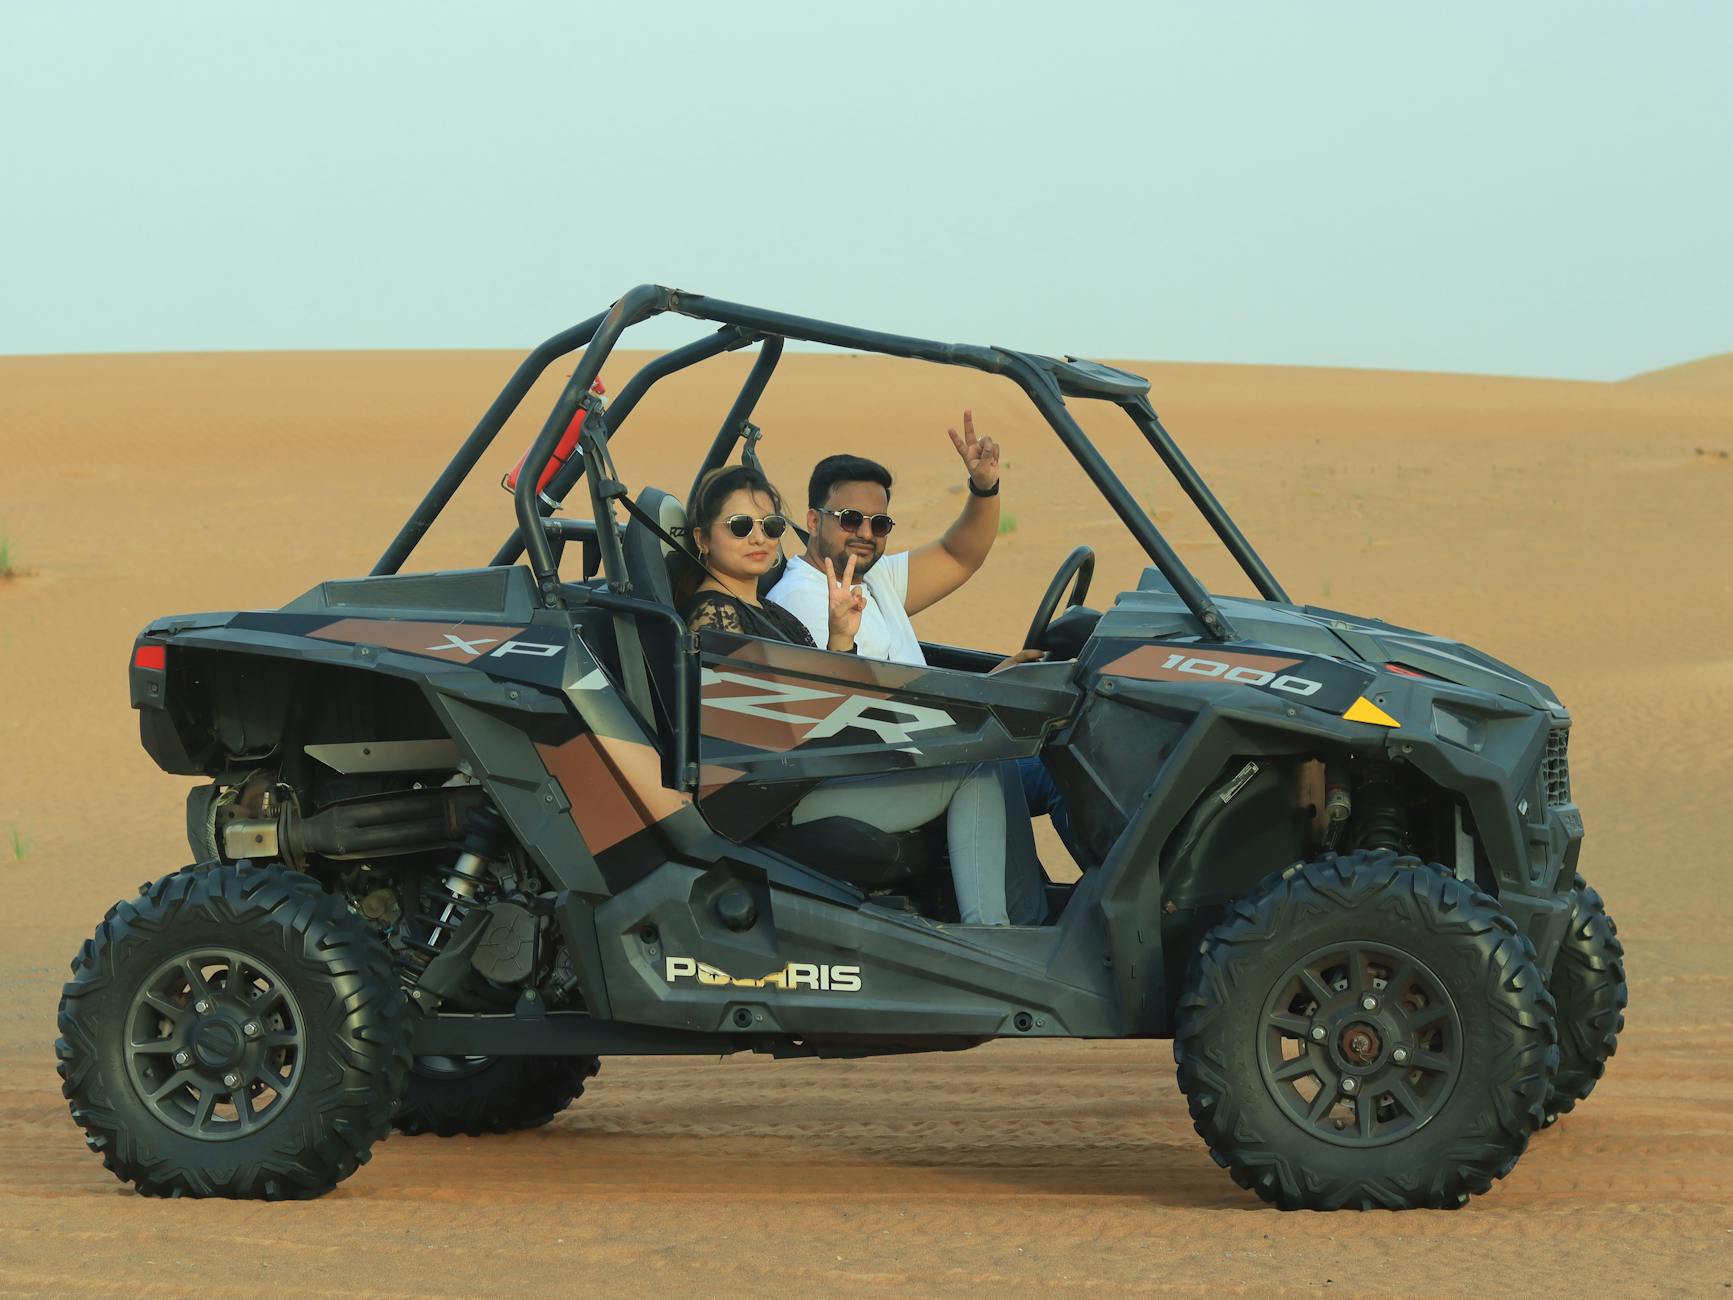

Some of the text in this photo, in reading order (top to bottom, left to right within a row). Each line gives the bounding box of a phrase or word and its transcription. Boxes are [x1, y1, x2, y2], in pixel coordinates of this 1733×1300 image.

[424, 634, 564, 658] XP
[1161, 654, 1323, 696] 1000
[701, 667, 957, 755] ZR
